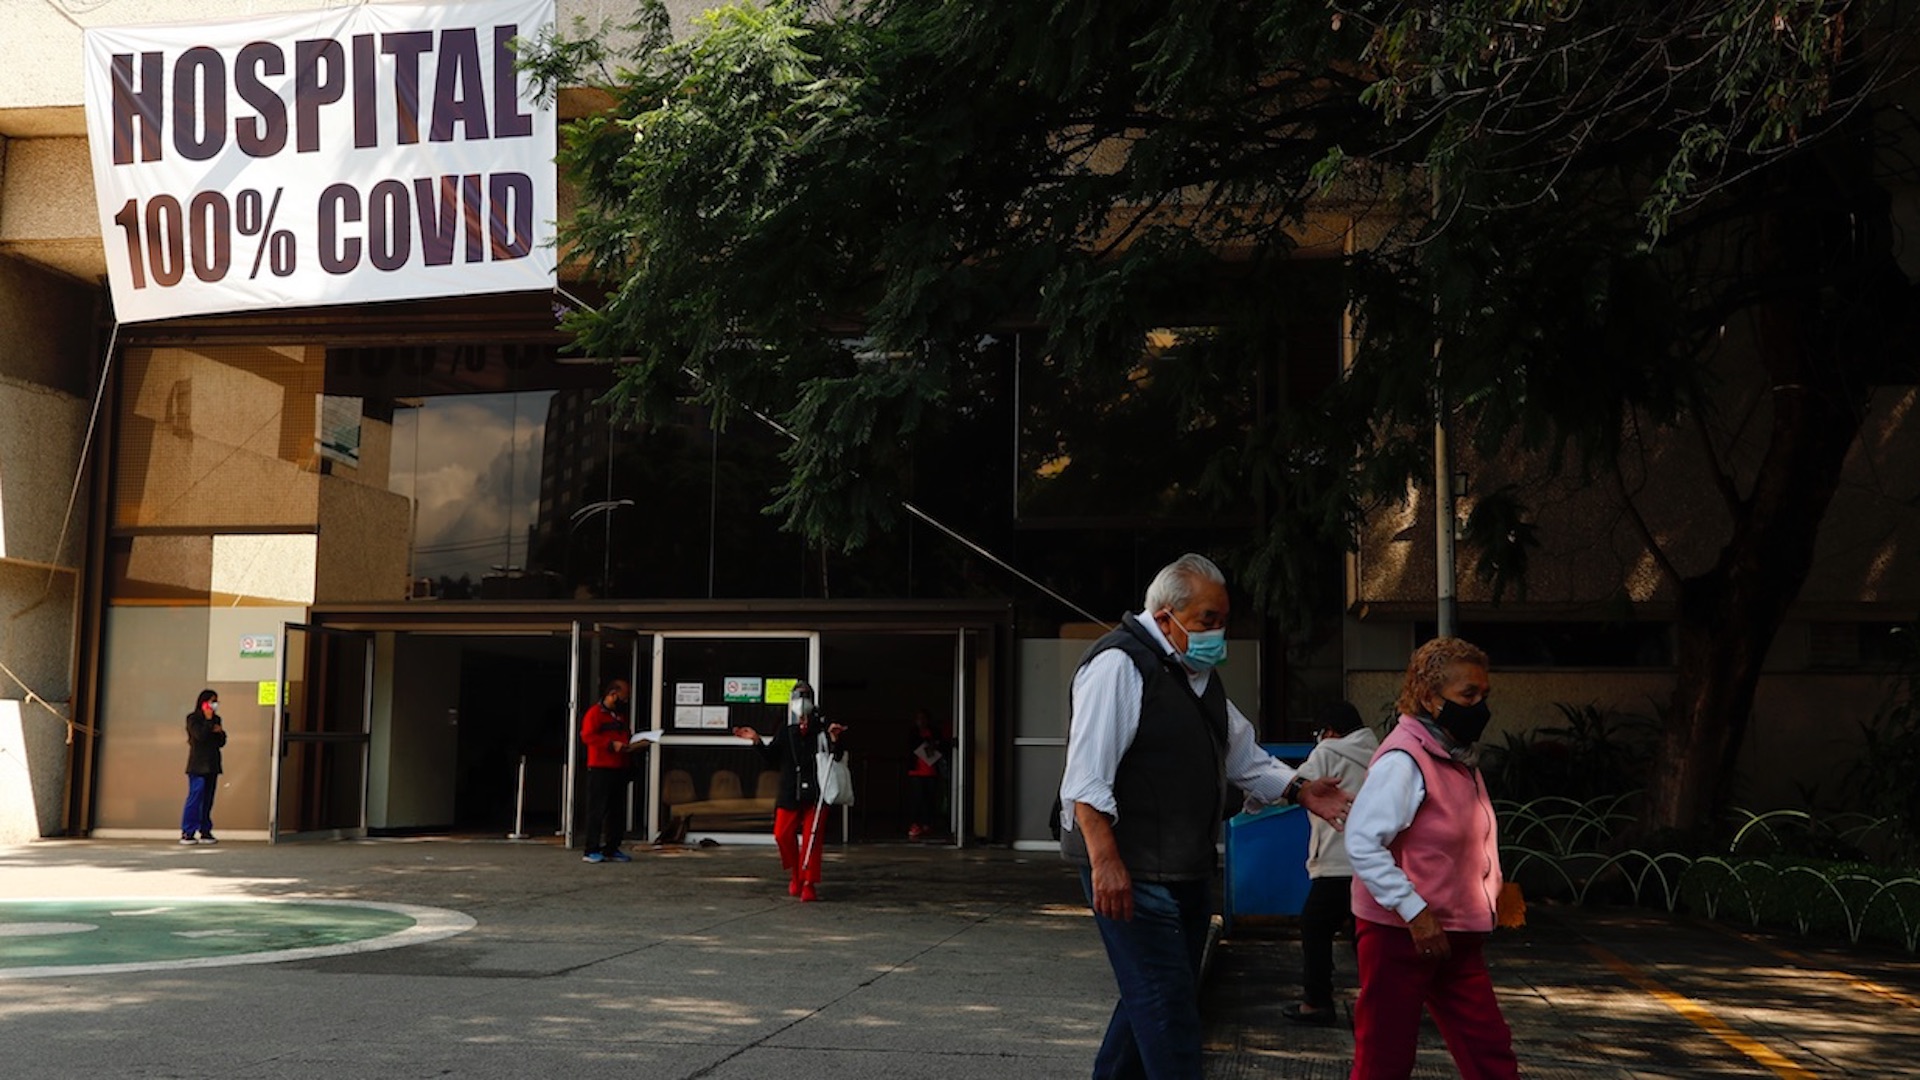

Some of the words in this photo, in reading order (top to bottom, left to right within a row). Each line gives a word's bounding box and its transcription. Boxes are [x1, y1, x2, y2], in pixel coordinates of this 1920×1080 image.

[112, 24, 532, 165] HOSPITAL
[115, 187, 296, 289] 100%
[318, 172, 534, 274] COVID
